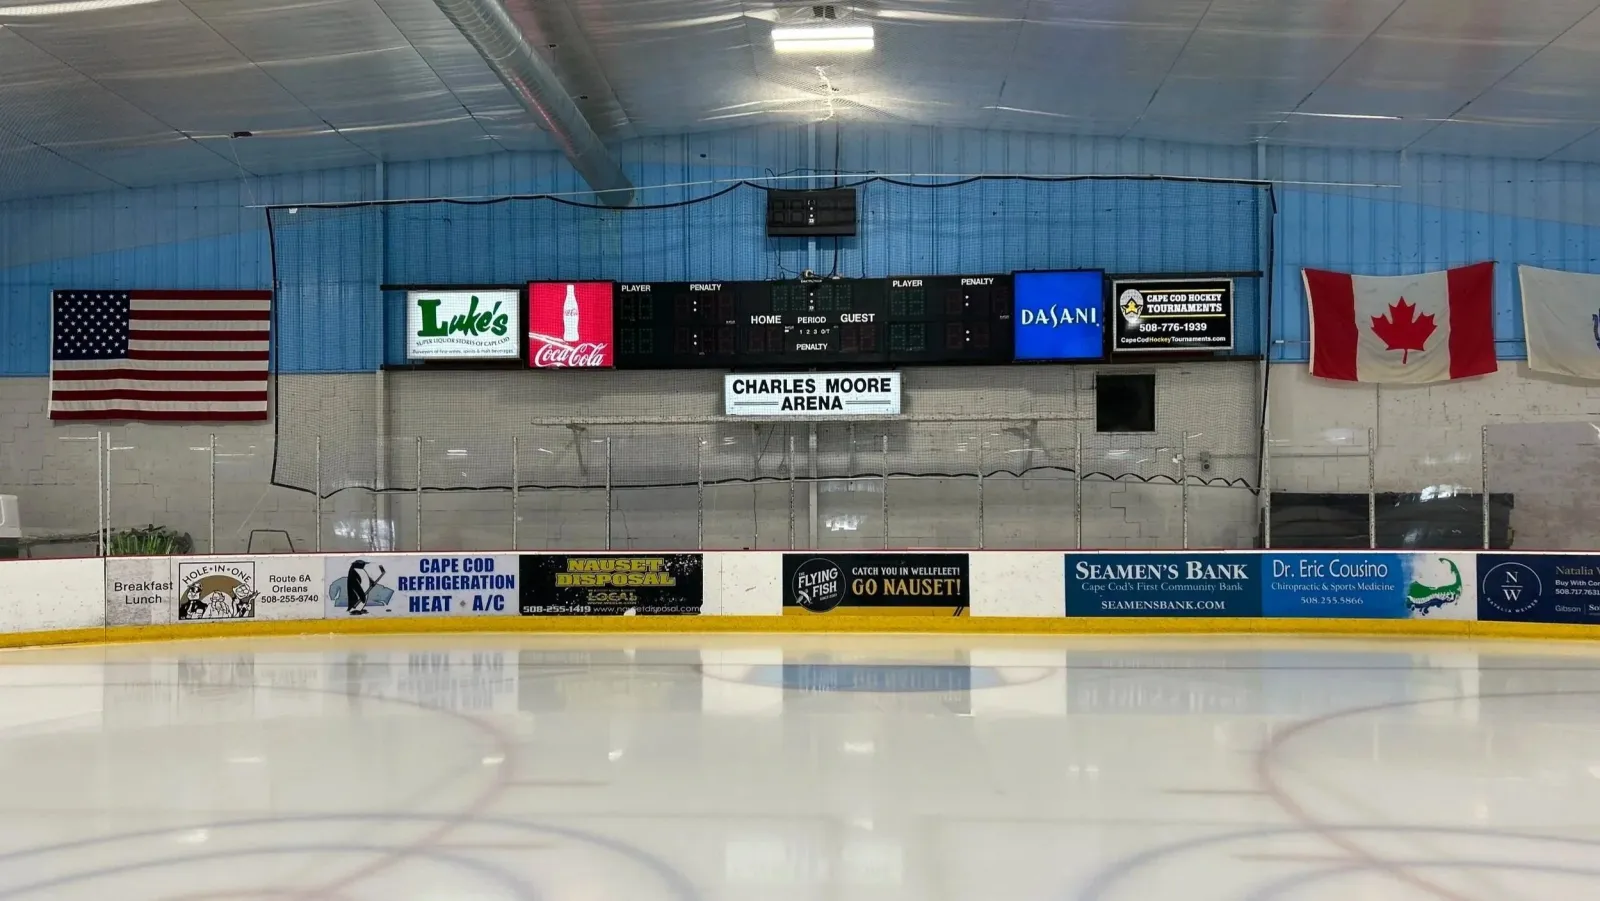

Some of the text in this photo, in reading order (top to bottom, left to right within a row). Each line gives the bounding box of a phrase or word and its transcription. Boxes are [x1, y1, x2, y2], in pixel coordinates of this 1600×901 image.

[961, 278, 994, 286] PENALTY
[1147, 293, 1222, 302] CAPE COD HOCKEY
[1146, 303, 1223, 313] TOURNAMENTS
[417, 295, 509, 337] Luke's
[750, 315, 782, 324] HOME
[797, 316, 827, 324] PERIOD
[840, 313, 876, 323] GUEST
[1021, 303, 1098, 329] DASANI
[1139, 322, 1208, 332] 508-776-1939
[1120, 336, 1226, 345] CapeCodHockeyTournaments.com
[732, 377, 892, 394] CHARLES MOORE
[781, 395, 843, 411] ARENA
[419, 557, 495, 574] CAPE COD
[567, 557, 664, 573] NAUSET
[1273, 558, 1388, 578] Dr. Eric Cousino
[1555, 565, 1594, 576] Natalia
[852, 567, 961, 576] CATCH YOU IN WELLFLEET!
[1505, 571, 1519, 583] N
[269, 574, 311, 582] Route 6A
[398, 574, 515, 591] REFRIGERATION
[555, 572, 676, 587] DISPOSAL
[798, 567, 839, 589] FLYING
[1555, 579, 1569, 587] Buy
[114, 580, 174, 592] Breakfast
[272, 584, 308, 593] Orleans
[812, 580, 838, 598] FISH
[851, 578, 962, 596] GO NAUSET!
[1081, 581, 1244, 593] Cape Cod's First Community Bank
[1271, 581, 1395, 592] Chiropractic & Sports Medicine
[125, 593, 162, 604] Lunch
[261, 594, 319, 603] 508-255-3740
[1503, 588, 1522, 601] W
[408, 594, 505, 612] HEAT A/C
[1101, 600, 1226, 610] SEAMENSBANK.COM
[1300, 596, 1364, 605] 508.255.5866
[523, 605, 591, 613] 508-255-1419
[1554, 604, 1582, 612] Gibson
